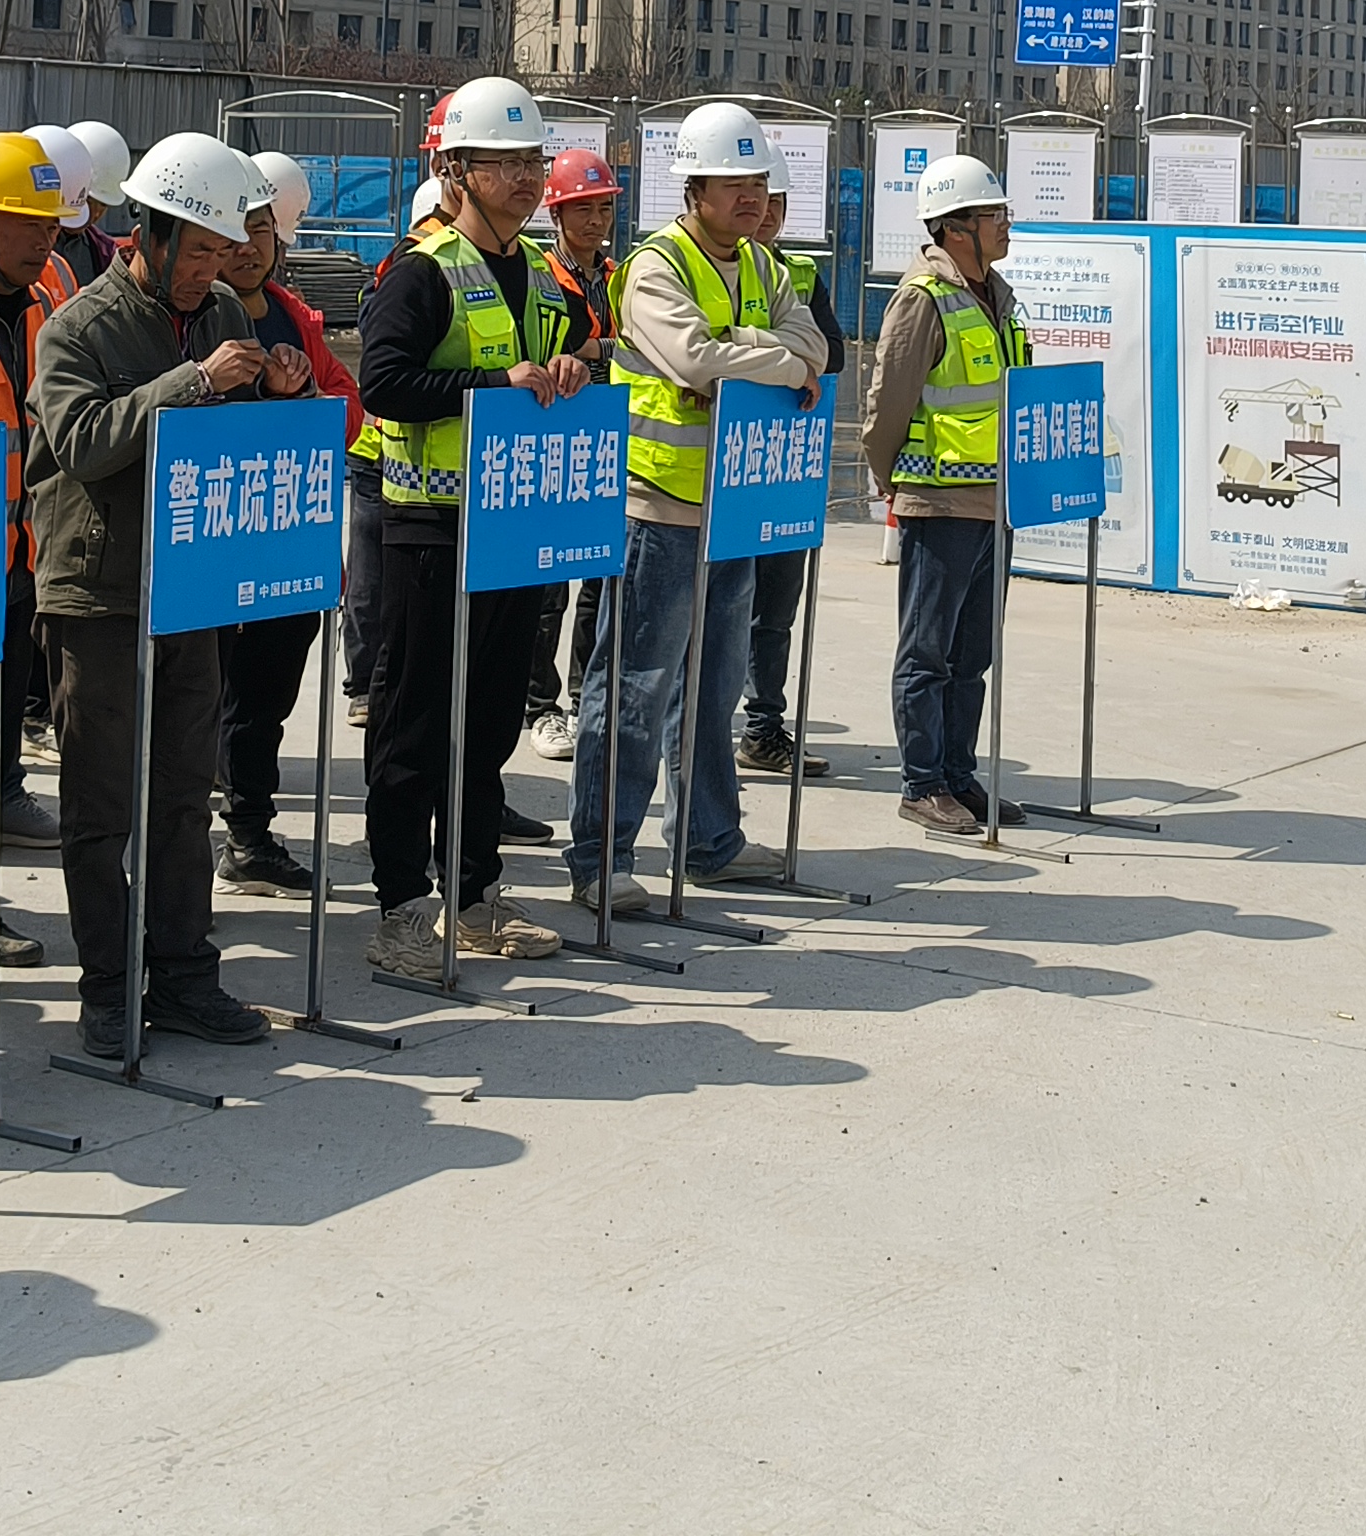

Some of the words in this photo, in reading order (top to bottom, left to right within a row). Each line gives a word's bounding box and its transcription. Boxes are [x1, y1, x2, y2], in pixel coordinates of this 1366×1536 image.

[927, 179, 955, 197] A-007
[165, 188, 212, 216] B-015
[1217, 277, 1340, 293] 全面落实安全生产主体责任
[1215, 311, 1344, 336] 进行高空作业
[1026, 327, 1111, 349] 安全用电
[1206, 336, 1354, 363] 请您佩戴安全带
[1013, 399, 1100, 464] 后勤保障组
[722, 416, 827, 488] 抢险救援组
[480, 428, 619, 510] 指挥调度组
[168, 448, 334, 545] 警戒疏散组
[556, 544, 611, 563] 中国建筑五局
[1210, 530, 1275, 547] 安全重于泰山
[1282, 536, 1349, 554] 文明促进发展
[259, 576, 324, 599] 中国建筑五局
